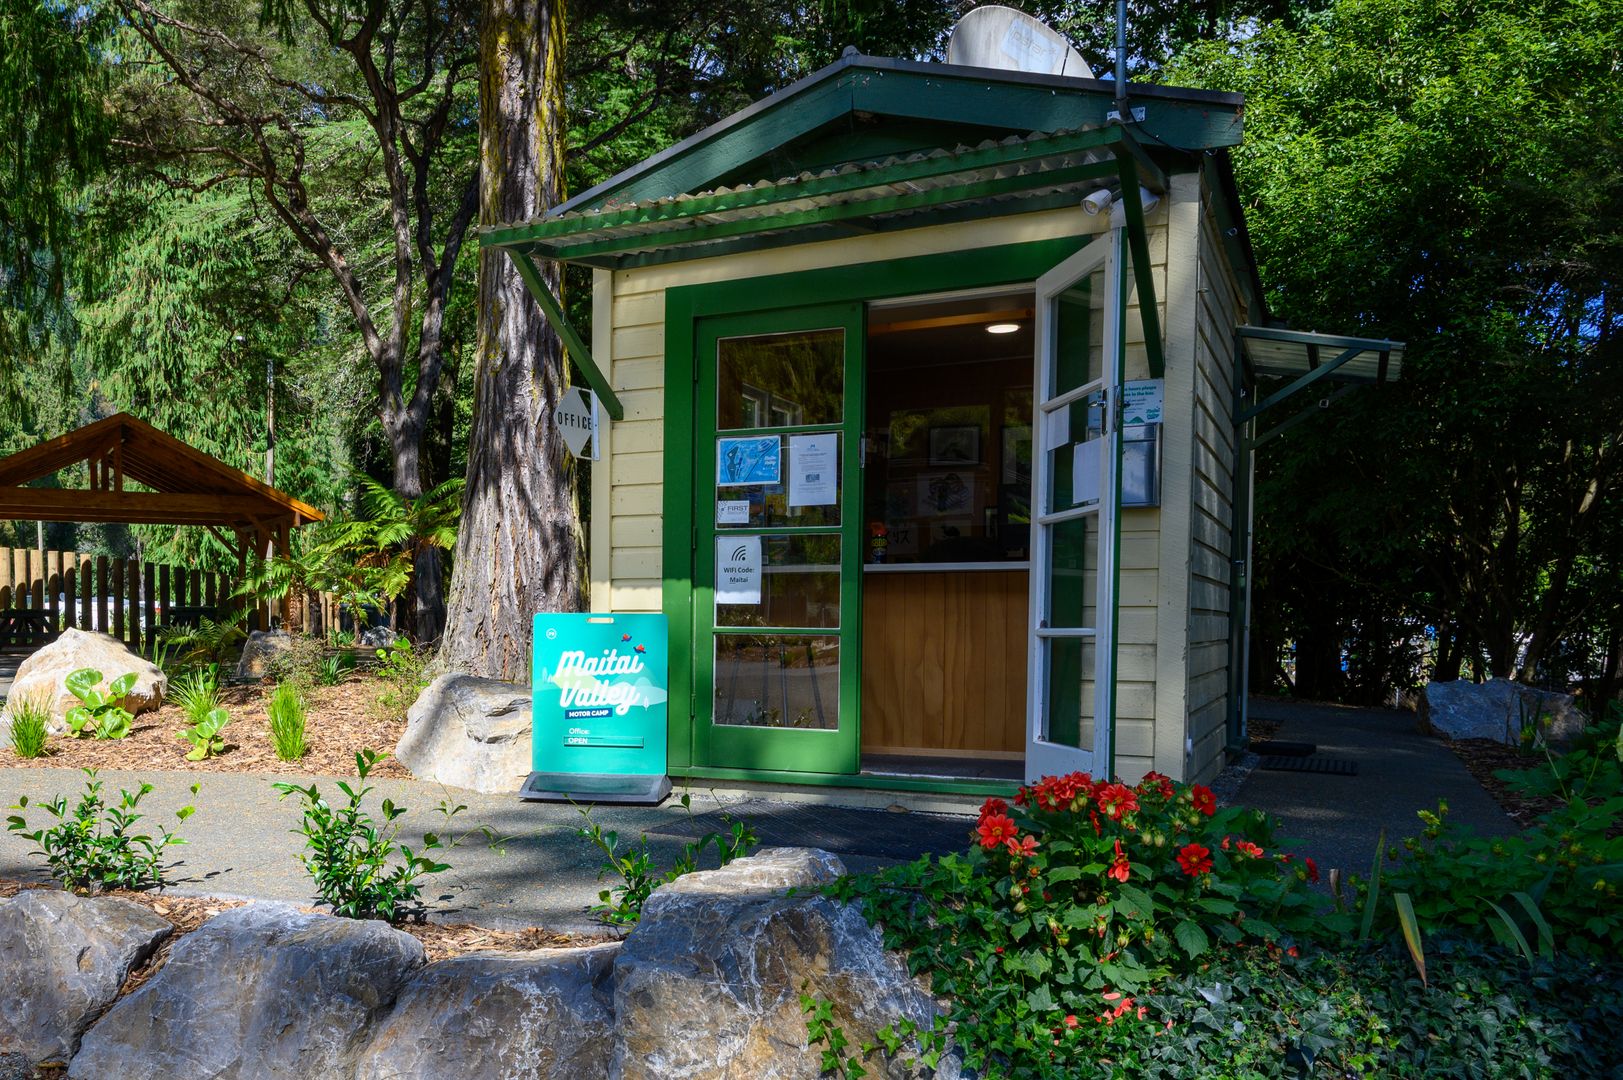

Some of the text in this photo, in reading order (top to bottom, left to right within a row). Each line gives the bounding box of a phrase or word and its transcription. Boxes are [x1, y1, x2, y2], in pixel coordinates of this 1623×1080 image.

[557, 412, 592, 430] OFFICE
[729, 576, 749, 584] Maitai
[555, 648, 644, 677] Maitai
[560, 679, 641, 715] Valley
